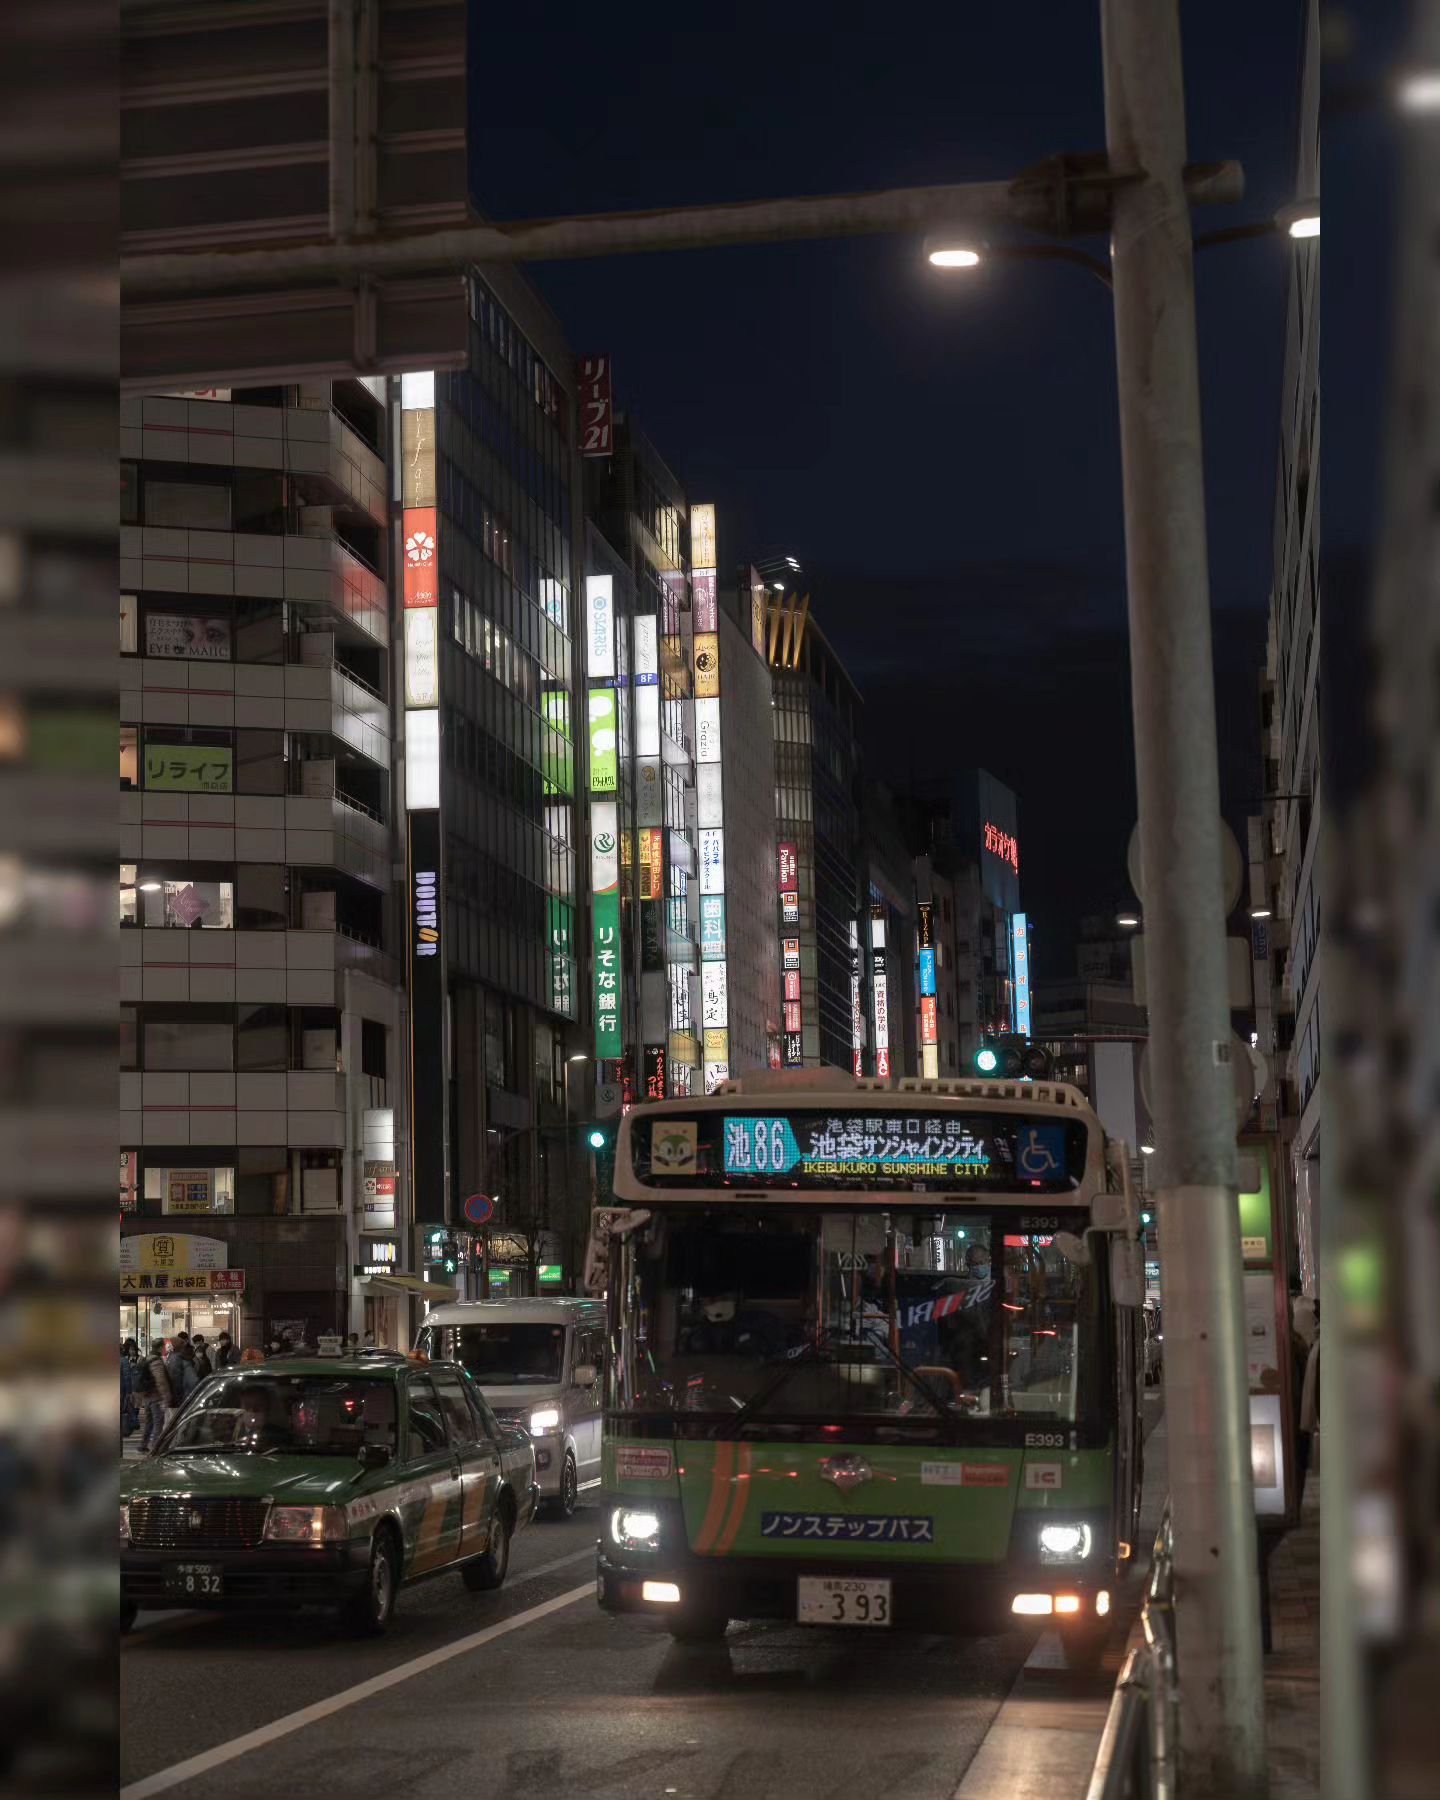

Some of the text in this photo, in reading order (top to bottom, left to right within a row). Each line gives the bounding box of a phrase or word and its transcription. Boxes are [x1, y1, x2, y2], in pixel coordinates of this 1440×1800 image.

[584, 357, 609, 450] リーブ21
[640, 673, 653, 683] 8F
[148, 760, 228, 781] リライフ
[780, 849, 789, 883] Pavilion
[415, 871, 440, 957] DOUTOR
[703, 899, 722, 939] 歯科
[921, 911, 929, 944] RIZAP
[597, 927, 617, 1032] りそな銀行
[876, 990, 887, 1032] 資格の学校
[877, 1049, 888, 1076] TAC
[826, 1118, 961, 1135] 池袋駅東口経由
[726, 1120, 785, 1170] 池86
[809, 1131, 985, 1160] 池袋サンシャインシティ
[803, 1162, 989, 1175] IKEBUKURO SUNSHINE CITY
[1020, 1216, 1058, 1229] E393
[122, 1274, 207, 1289] 大黒屋 池袋店
[1025, 1434, 1064, 1447] E393
[762, 1515, 933, 1540] ノンステップバス
[832, 1593, 887, 1621] 393
